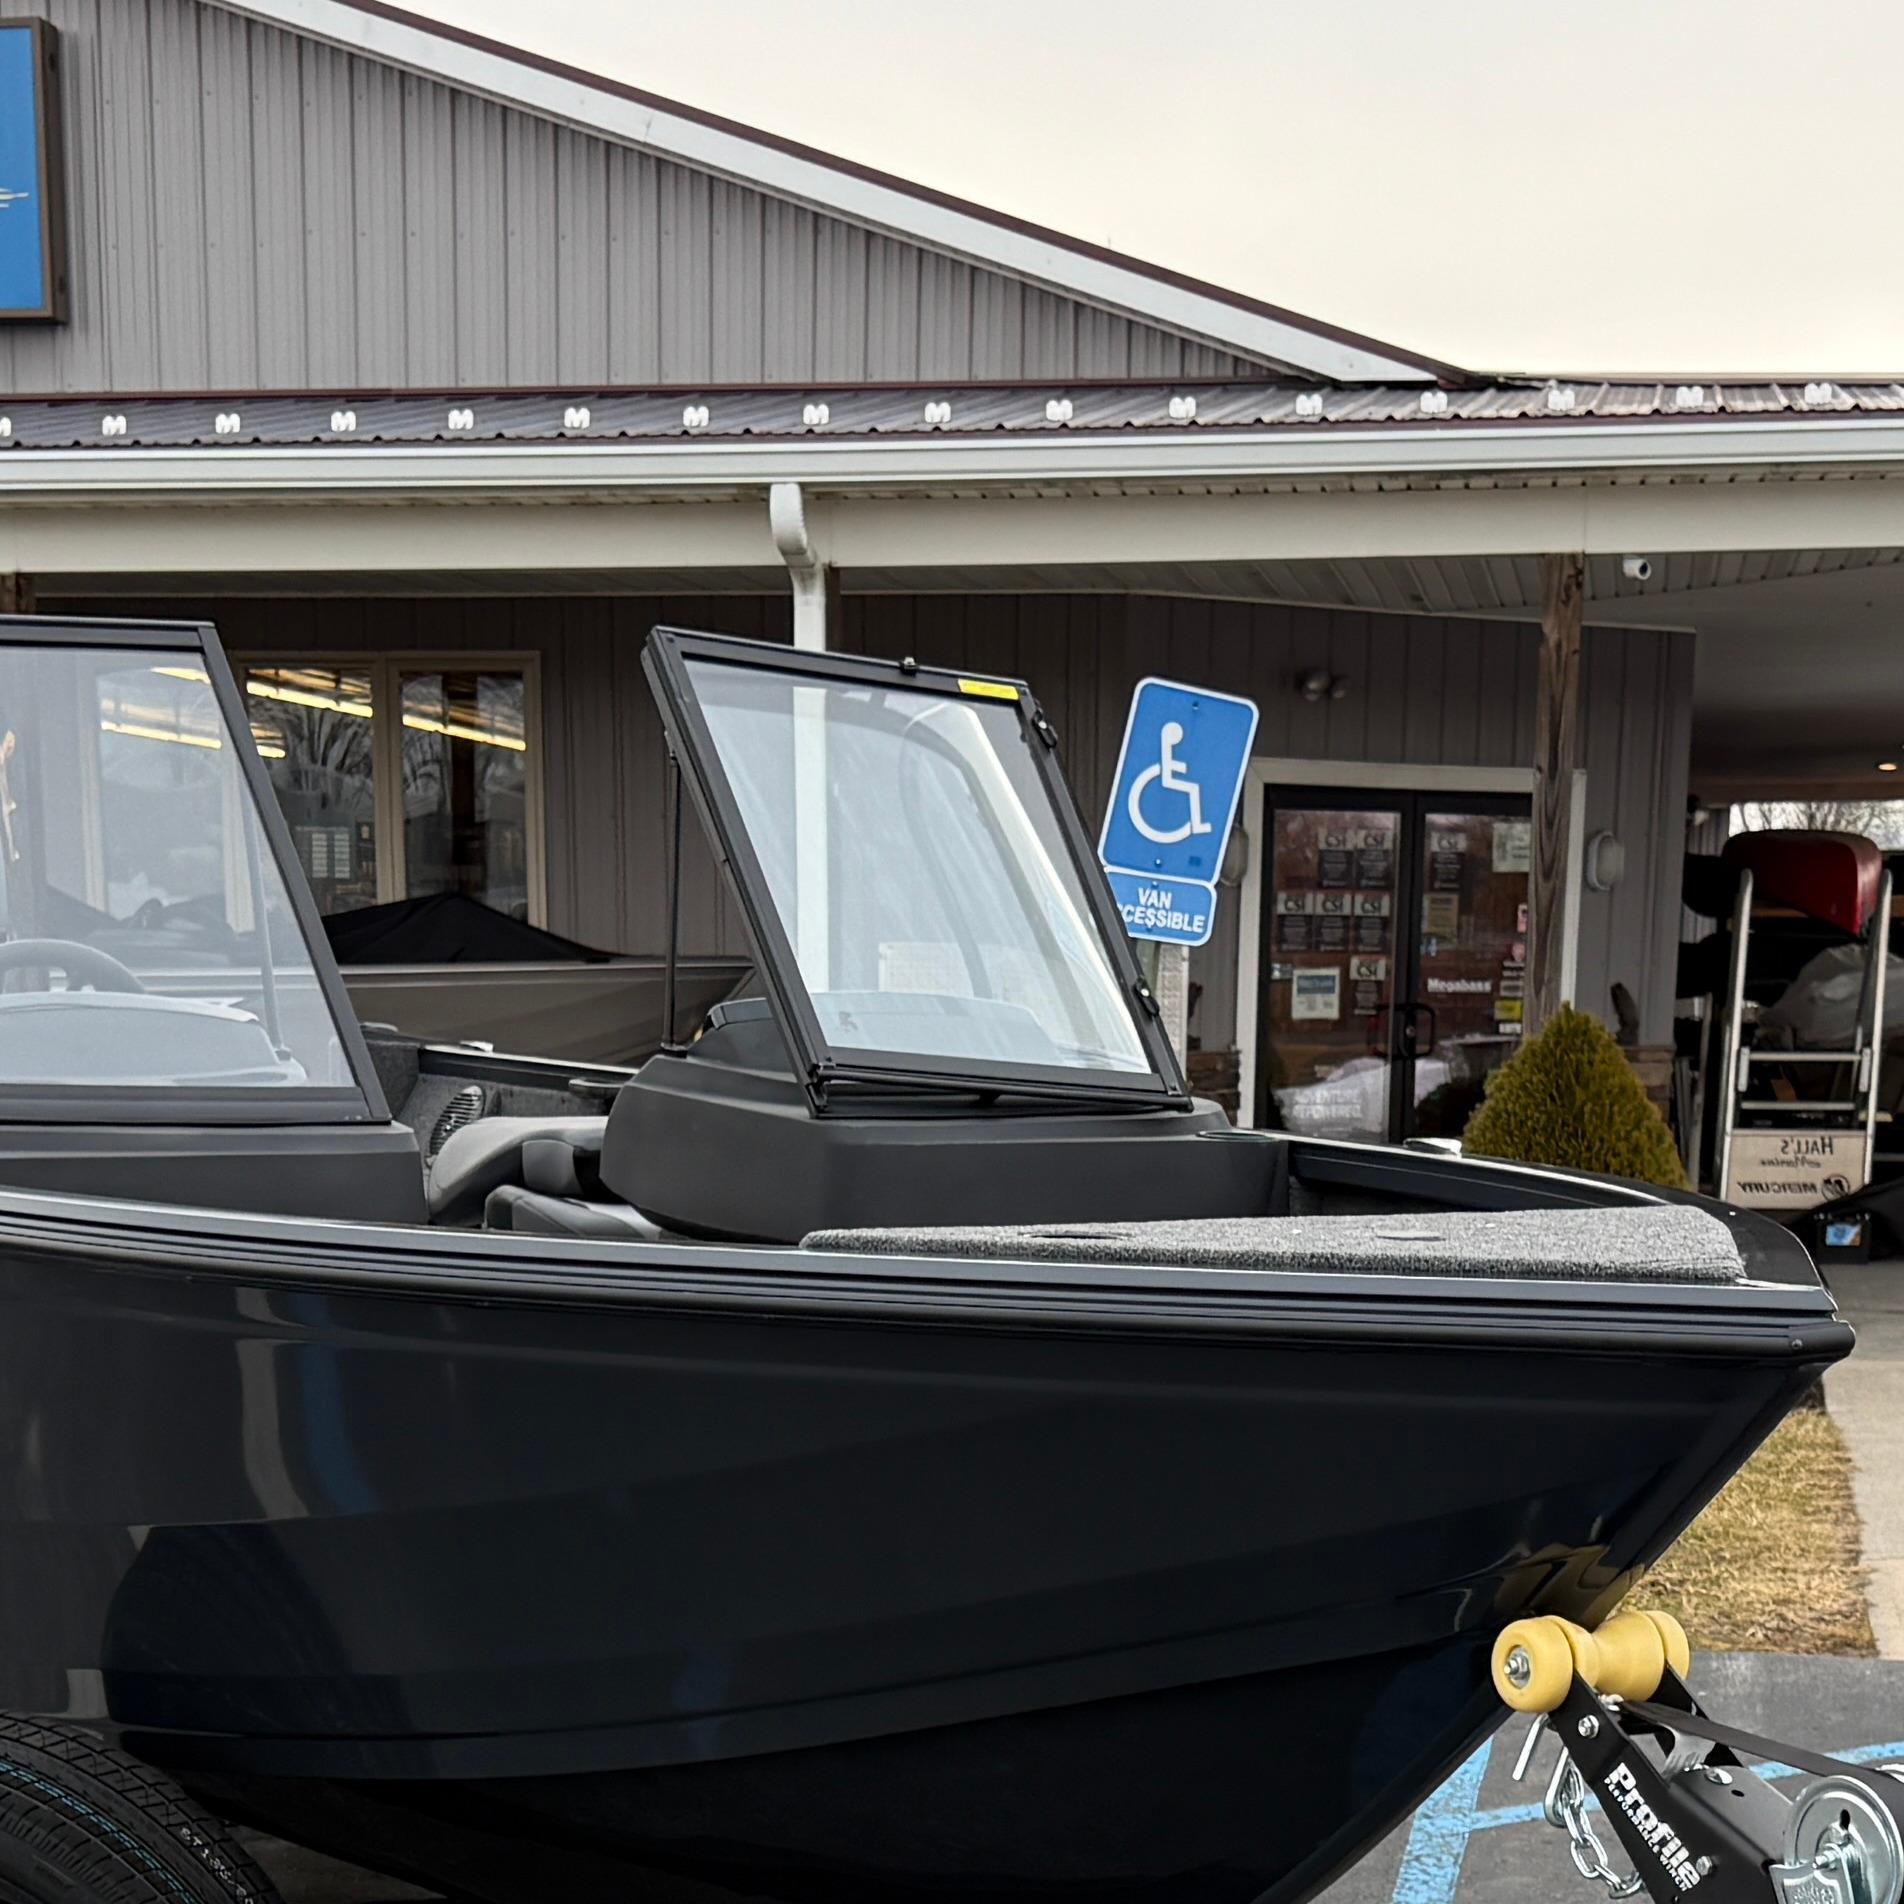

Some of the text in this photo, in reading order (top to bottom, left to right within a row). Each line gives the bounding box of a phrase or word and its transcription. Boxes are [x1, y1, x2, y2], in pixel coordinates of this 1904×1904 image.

[1138, 887, 1172, 910] VAN
[1117, 902, 1205, 933] CESSIBLE
[1427, 978, 1493, 993] Megabass
[1607, 1762, 1701, 1889] Profile
